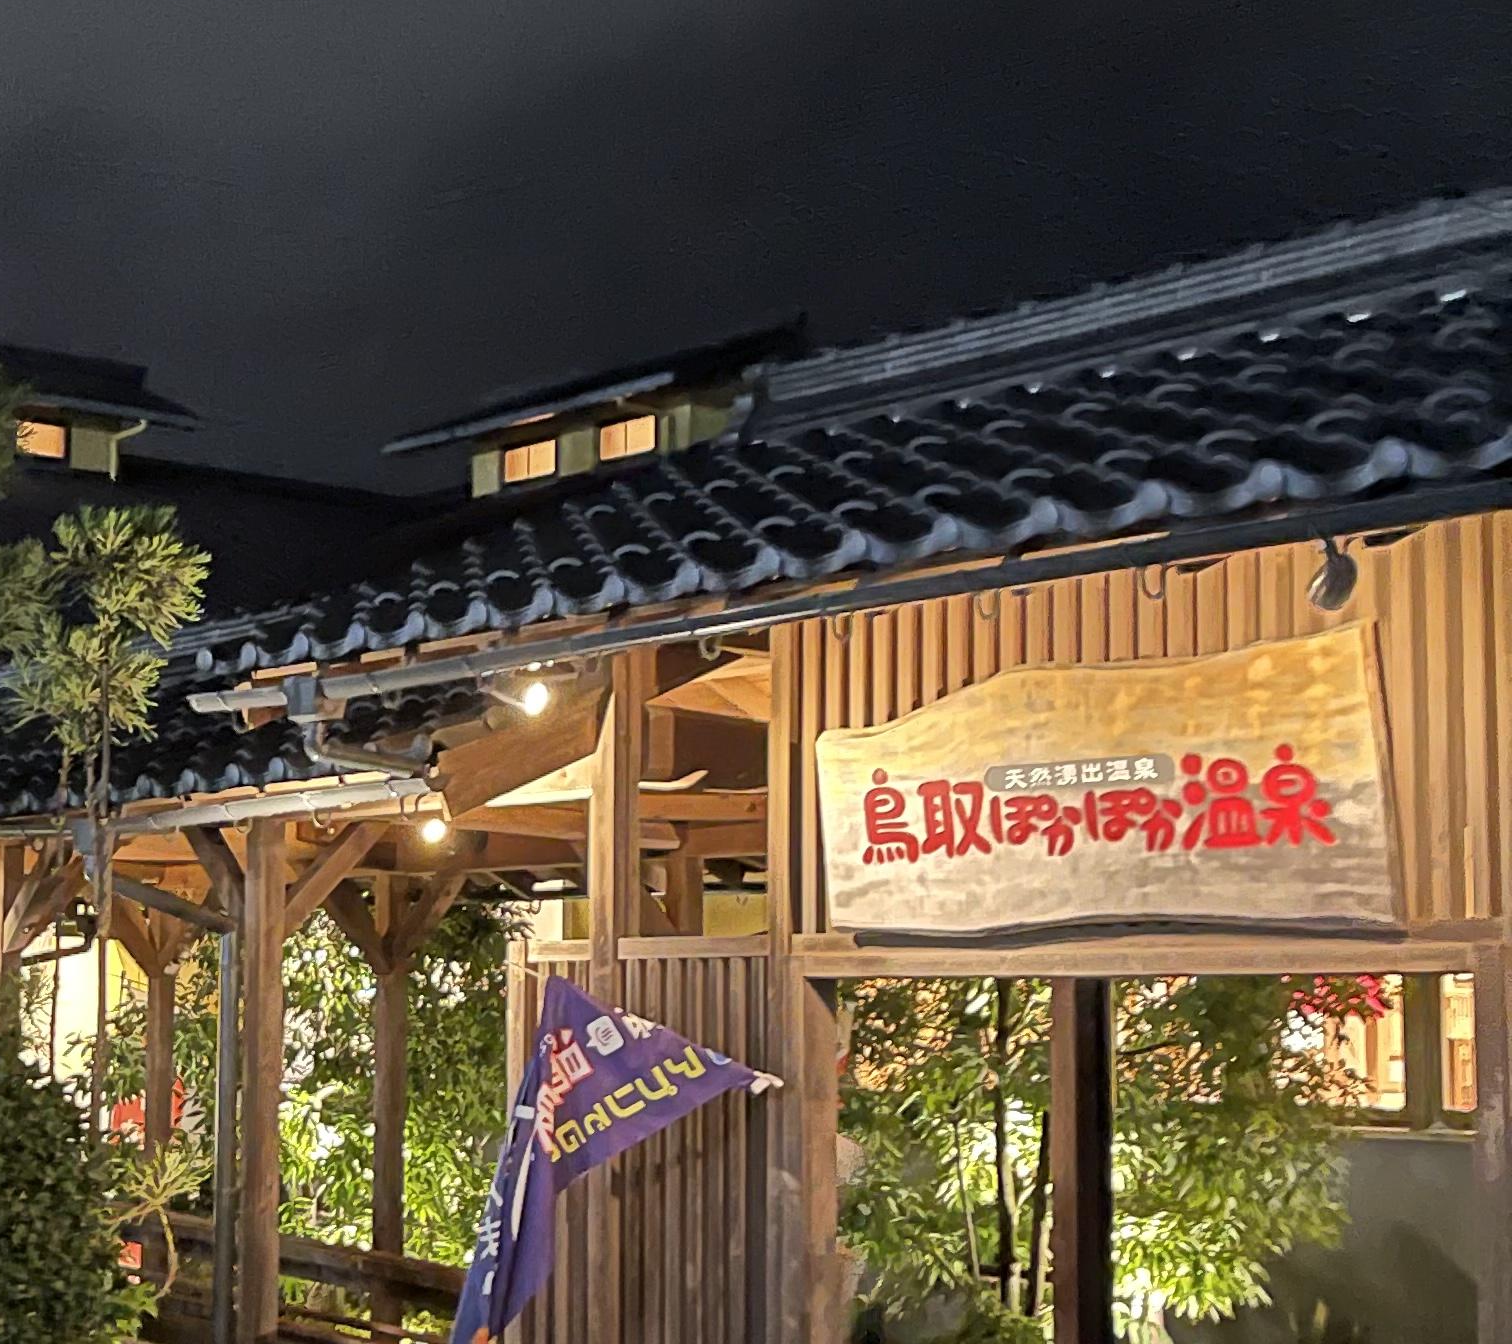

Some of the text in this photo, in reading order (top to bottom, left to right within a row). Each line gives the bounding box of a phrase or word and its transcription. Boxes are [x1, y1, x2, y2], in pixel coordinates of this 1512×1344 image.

[863, 744, 1337, 864] 鳥取ぽかぽか温泉
[1004, 757, 1159, 790] 天然湧出温泉
[551, 1045, 707, 1163] アプリでG
